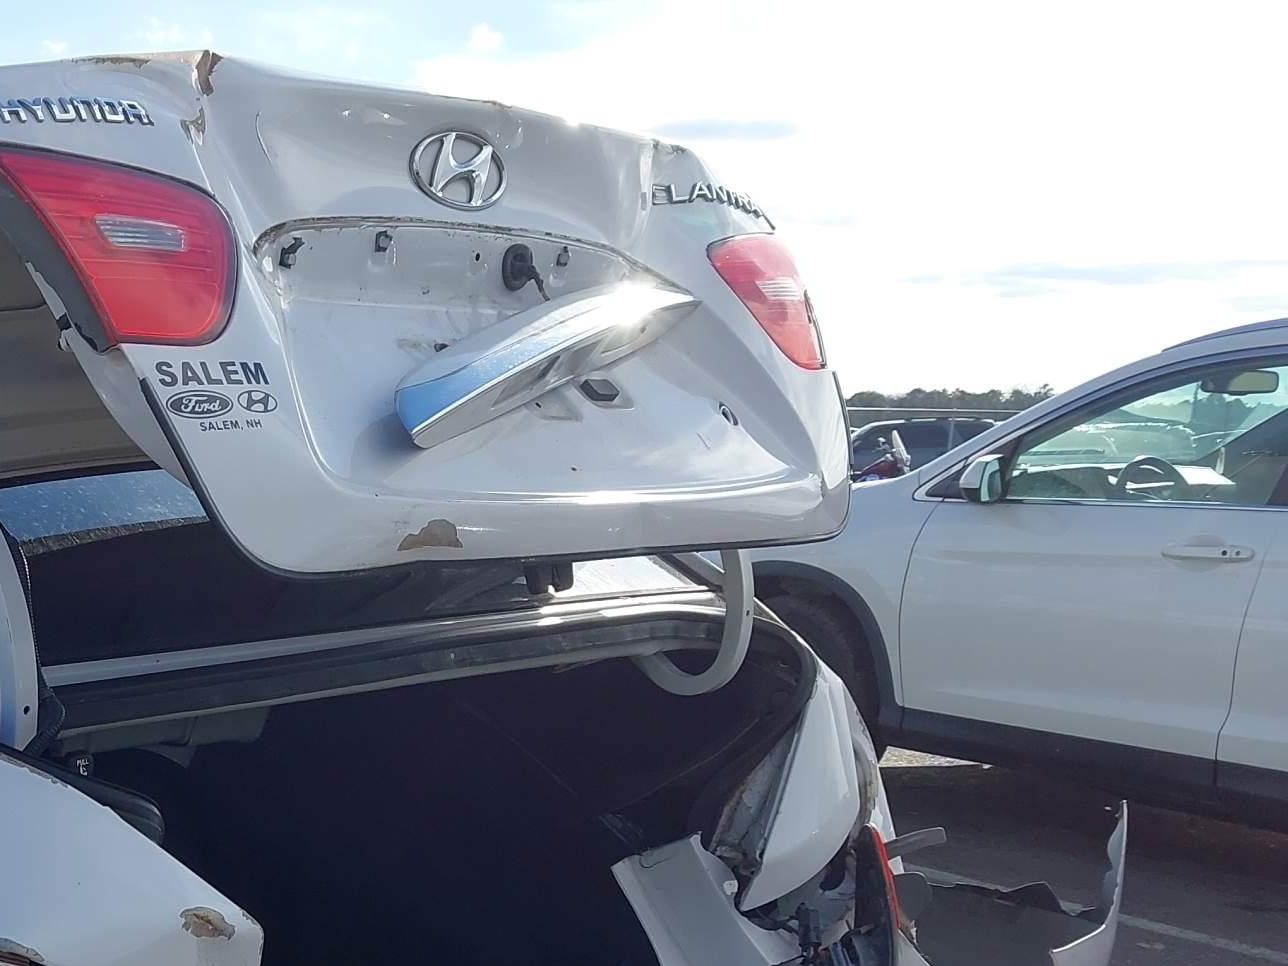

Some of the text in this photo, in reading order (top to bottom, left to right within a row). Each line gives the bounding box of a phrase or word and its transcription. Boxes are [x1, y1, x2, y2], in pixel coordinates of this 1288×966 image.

[155, 361, 270, 387] SALEM
[199, 419, 263, 432] SALEM, NH
